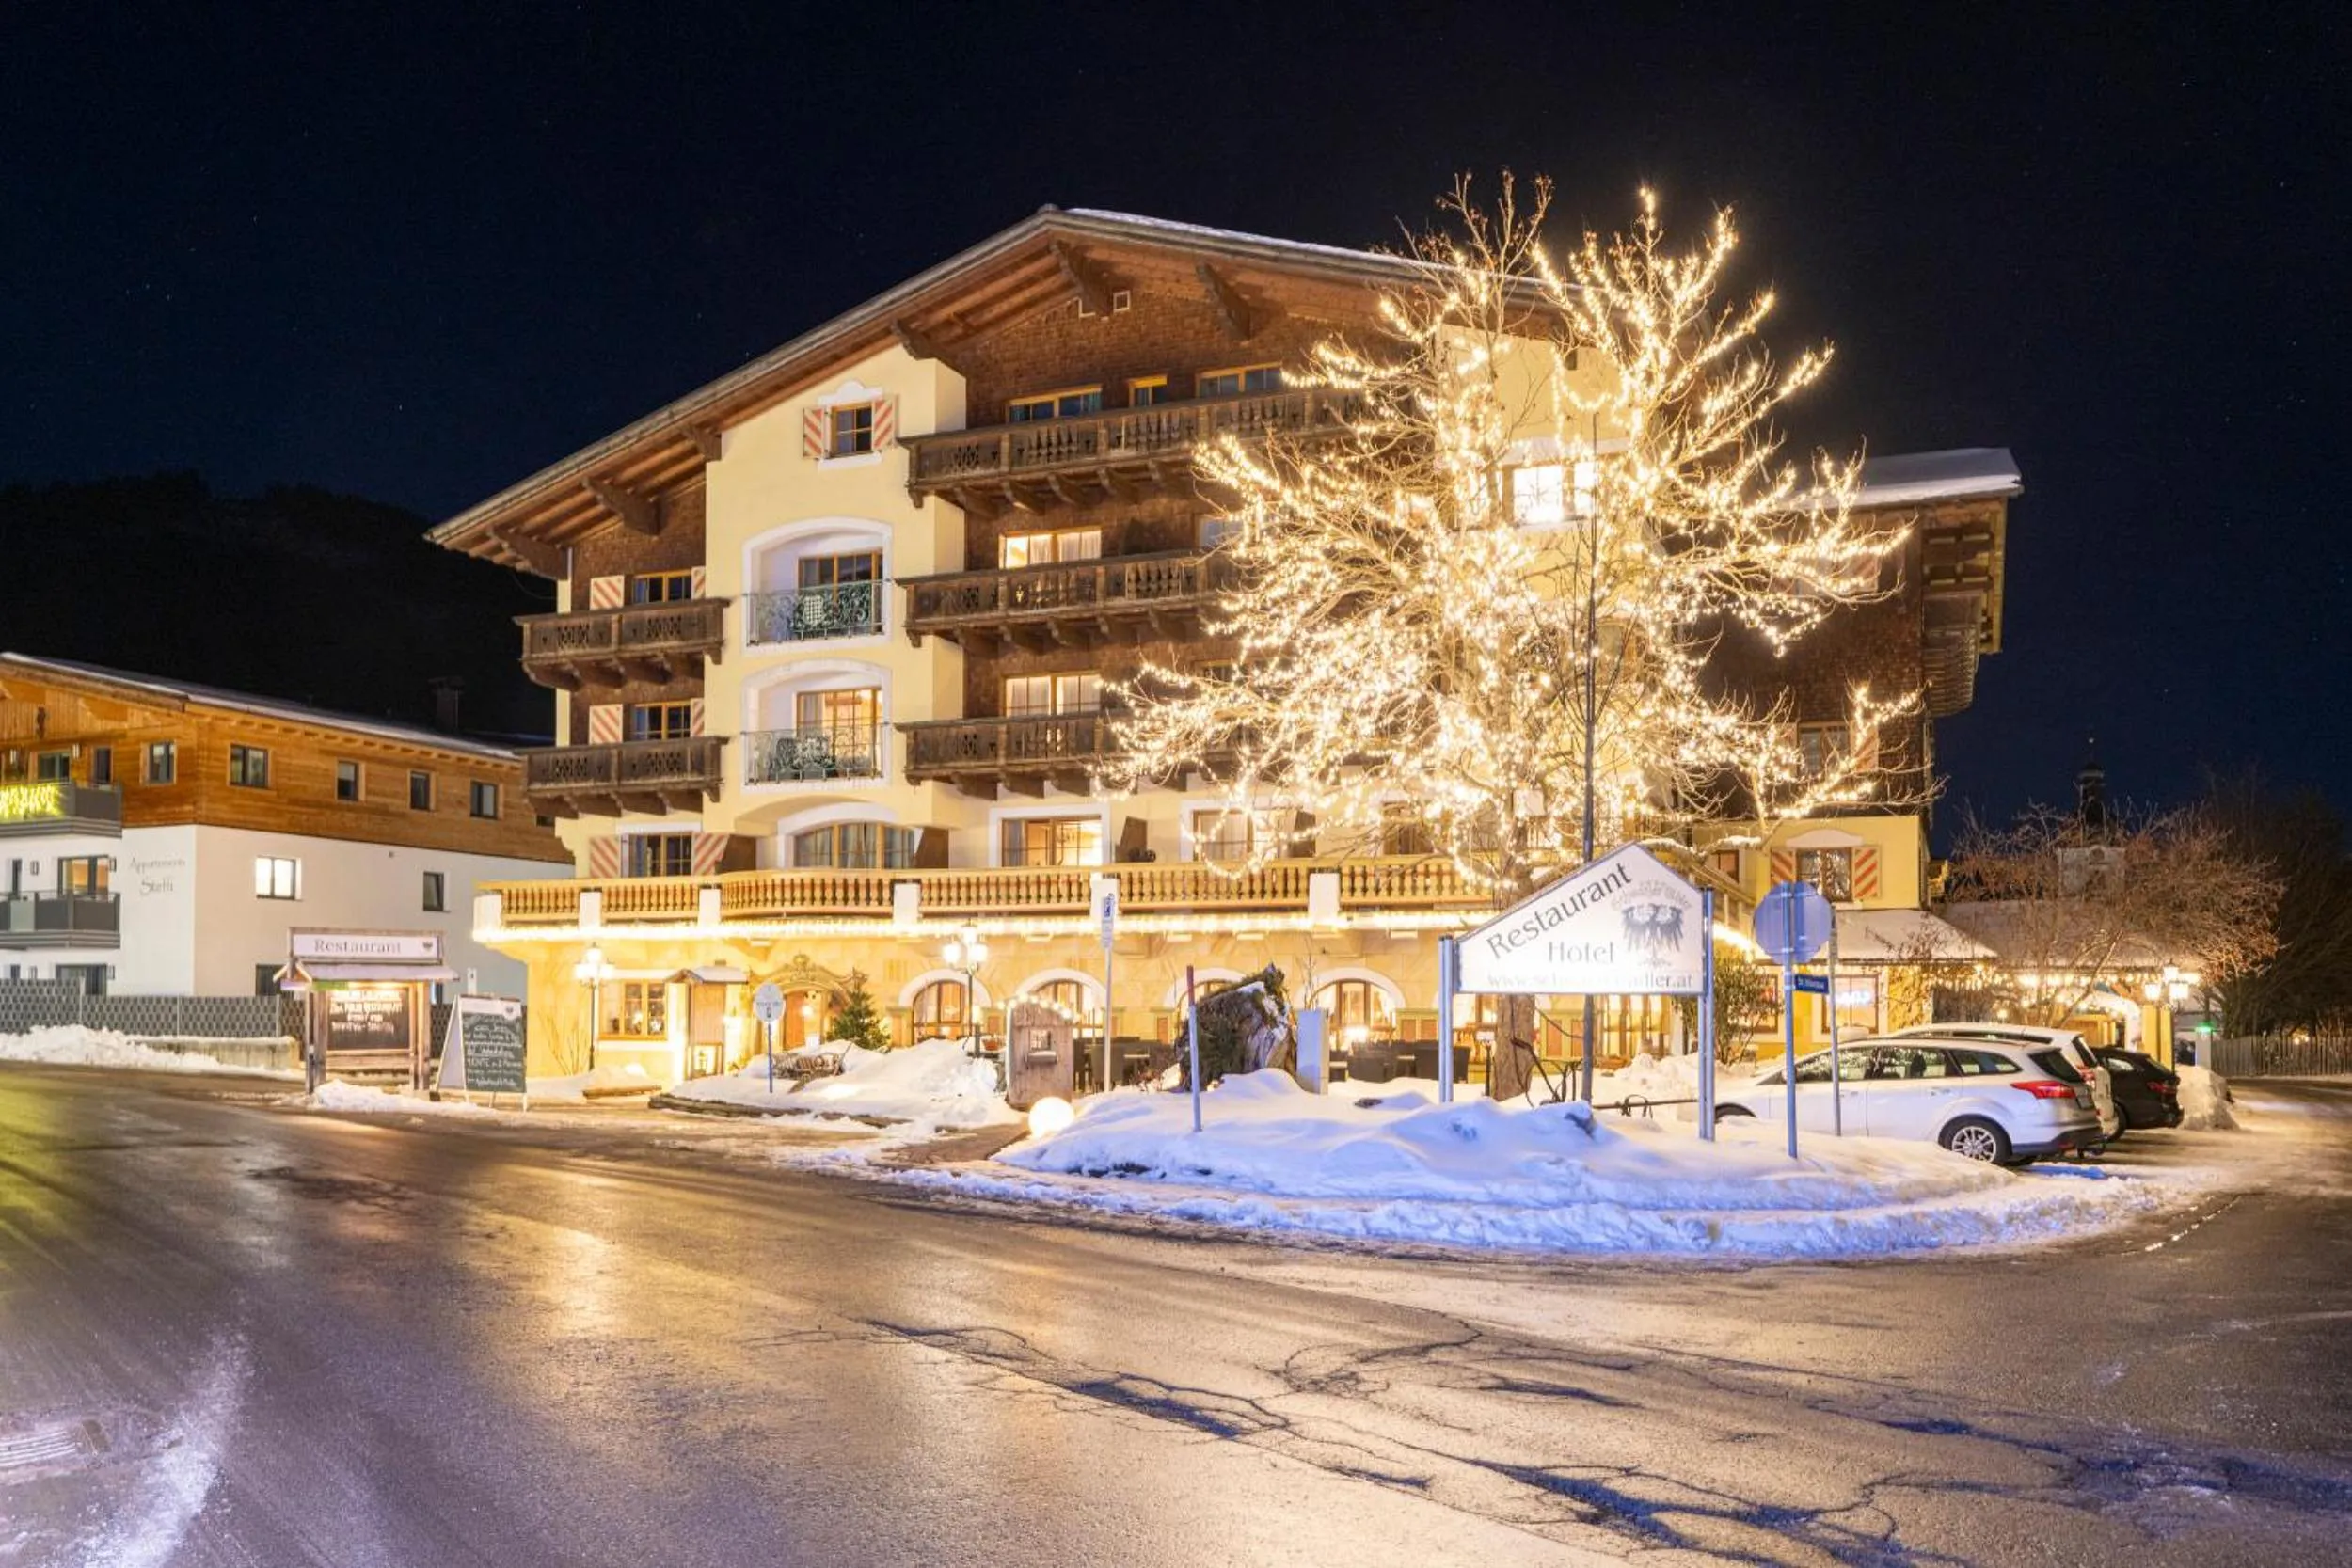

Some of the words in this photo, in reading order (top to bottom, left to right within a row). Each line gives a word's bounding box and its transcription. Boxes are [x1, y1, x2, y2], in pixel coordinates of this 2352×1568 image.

[1486, 862, 1632, 959] Restaurant
[313, 938, 401, 954] Restaurant
[1548, 941, 1614, 963] Hotel
